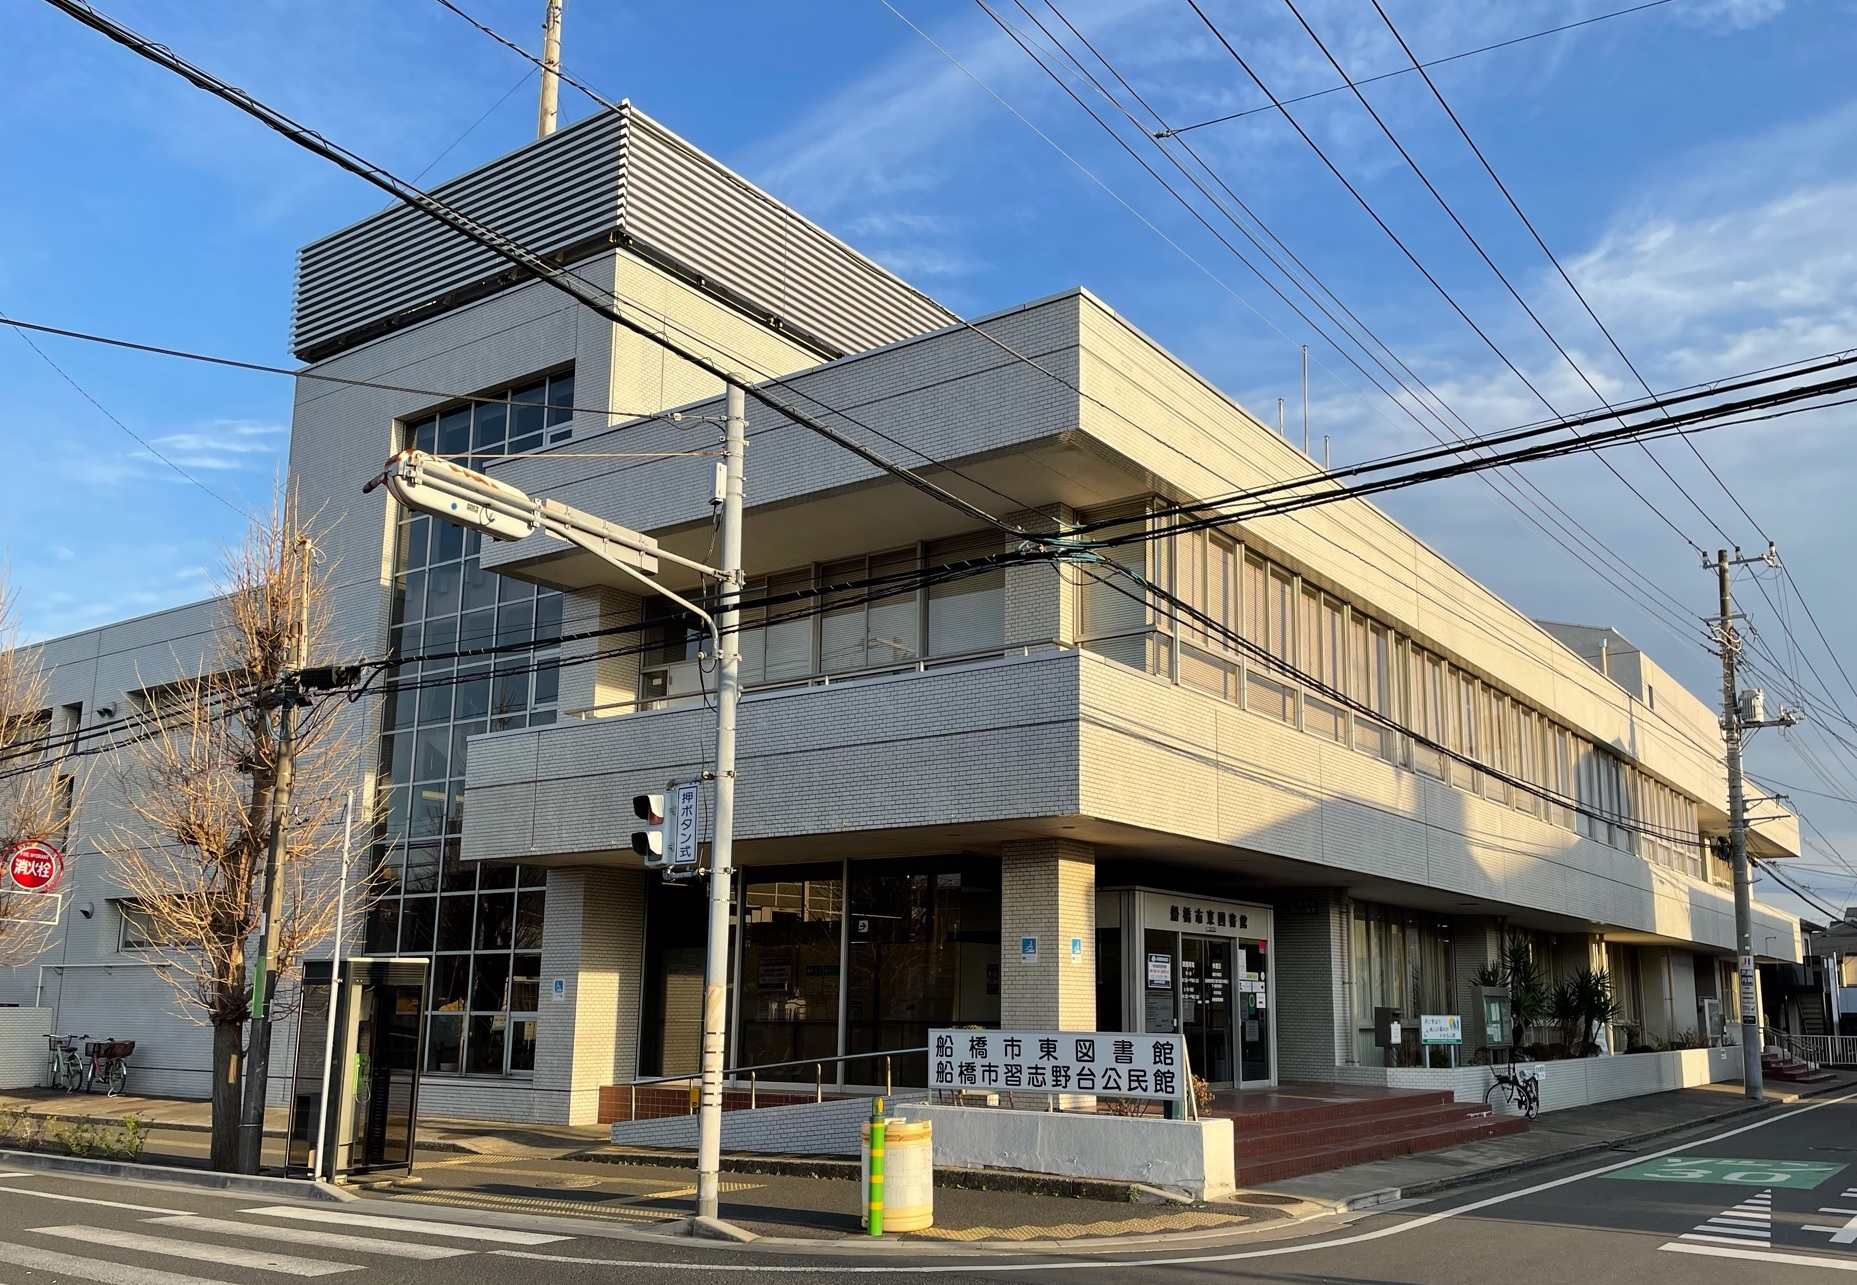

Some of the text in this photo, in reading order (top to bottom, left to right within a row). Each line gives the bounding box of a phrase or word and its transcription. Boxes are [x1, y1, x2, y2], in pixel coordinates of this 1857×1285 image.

[679, 791, 694, 857] 押ボタン式
[13, 858, 52, 878] 消火栓
[1169, 904, 1248, 929] 船橋市東図書館
[935, 1034, 1175, 1066] 船橋市東図書館
[935, 1060, 1176, 1095] 船橋市習志野台公民館
[1643, 1168, 1792, 1183] 30
